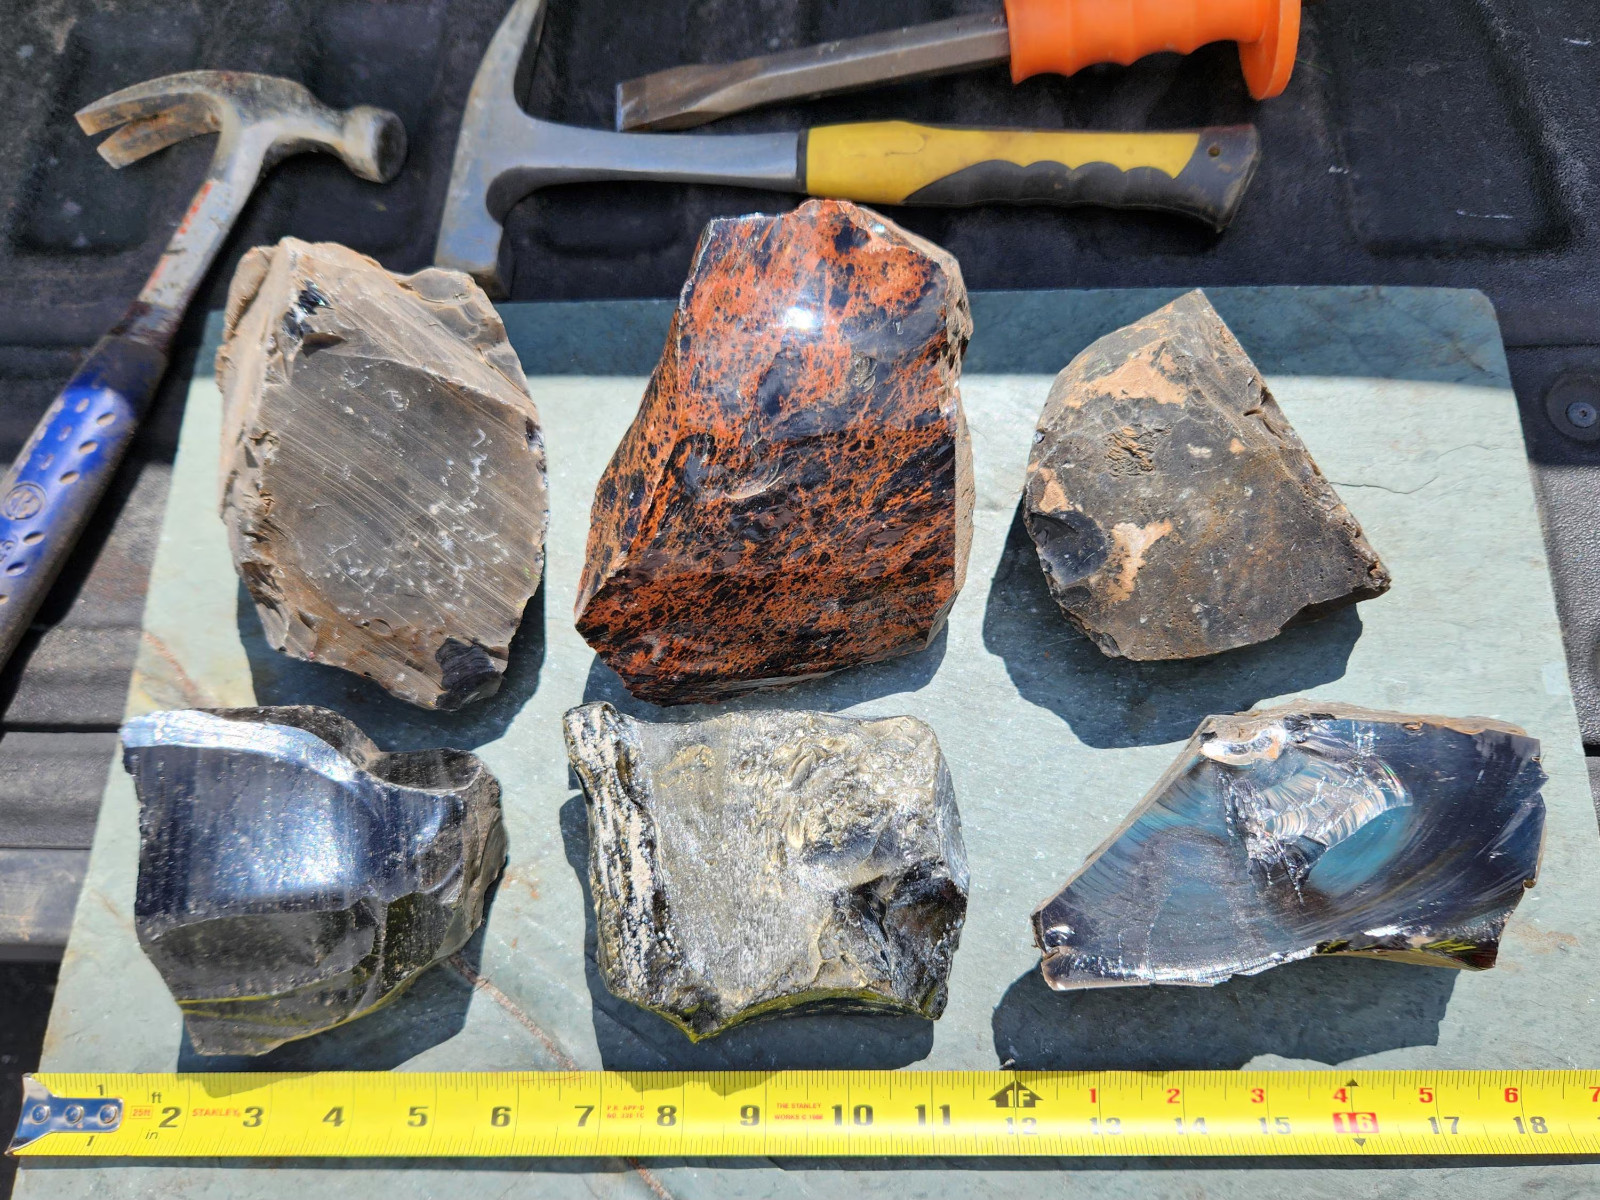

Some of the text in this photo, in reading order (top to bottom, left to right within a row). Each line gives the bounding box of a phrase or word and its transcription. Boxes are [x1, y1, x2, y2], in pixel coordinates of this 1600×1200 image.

[97, 1084, 104, 1096] 1
[151, 1092, 162, 1103] ft
[1089, 1088, 1098, 1103] 1
[1166, 1088, 1181, 1103] 2
[1250, 1088, 1265, 1103] 3
[1333, 1087, 1348, 1103] 4
[1419, 1087, 1433, 1103] 5
[1504, 1087, 1519, 1103] 6
[159, 1106, 182, 1128] 2
[243, 1106, 264, 1127] 3
[322, 1106, 345, 1127] 4
[407, 1106, 428, 1127] 5
[490, 1106, 512, 1127] 6
[574, 1105, 595, 1127] 7
[656, 1105, 678, 1127] 8
[740, 1105, 761, 1126] 9
[830, 1104, 874, 1126] 10
[914, 1104, 951, 1126] 11
[1338, 1113, 1373, 1133] 16
[145, 1129, 158, 1140] in
[1005, 1116, 1038, 1135] 12
[1089, 1116, 1122, 1135] 13
[1173, 1116, 1208, 1135] 14
[1258, 1116, 1292, 1135] 15
[1427, 1116, 1460, 1135] 17
[1512, 1116, 1549, 1134] 18
[87, 1135, 95, 1146] 1
